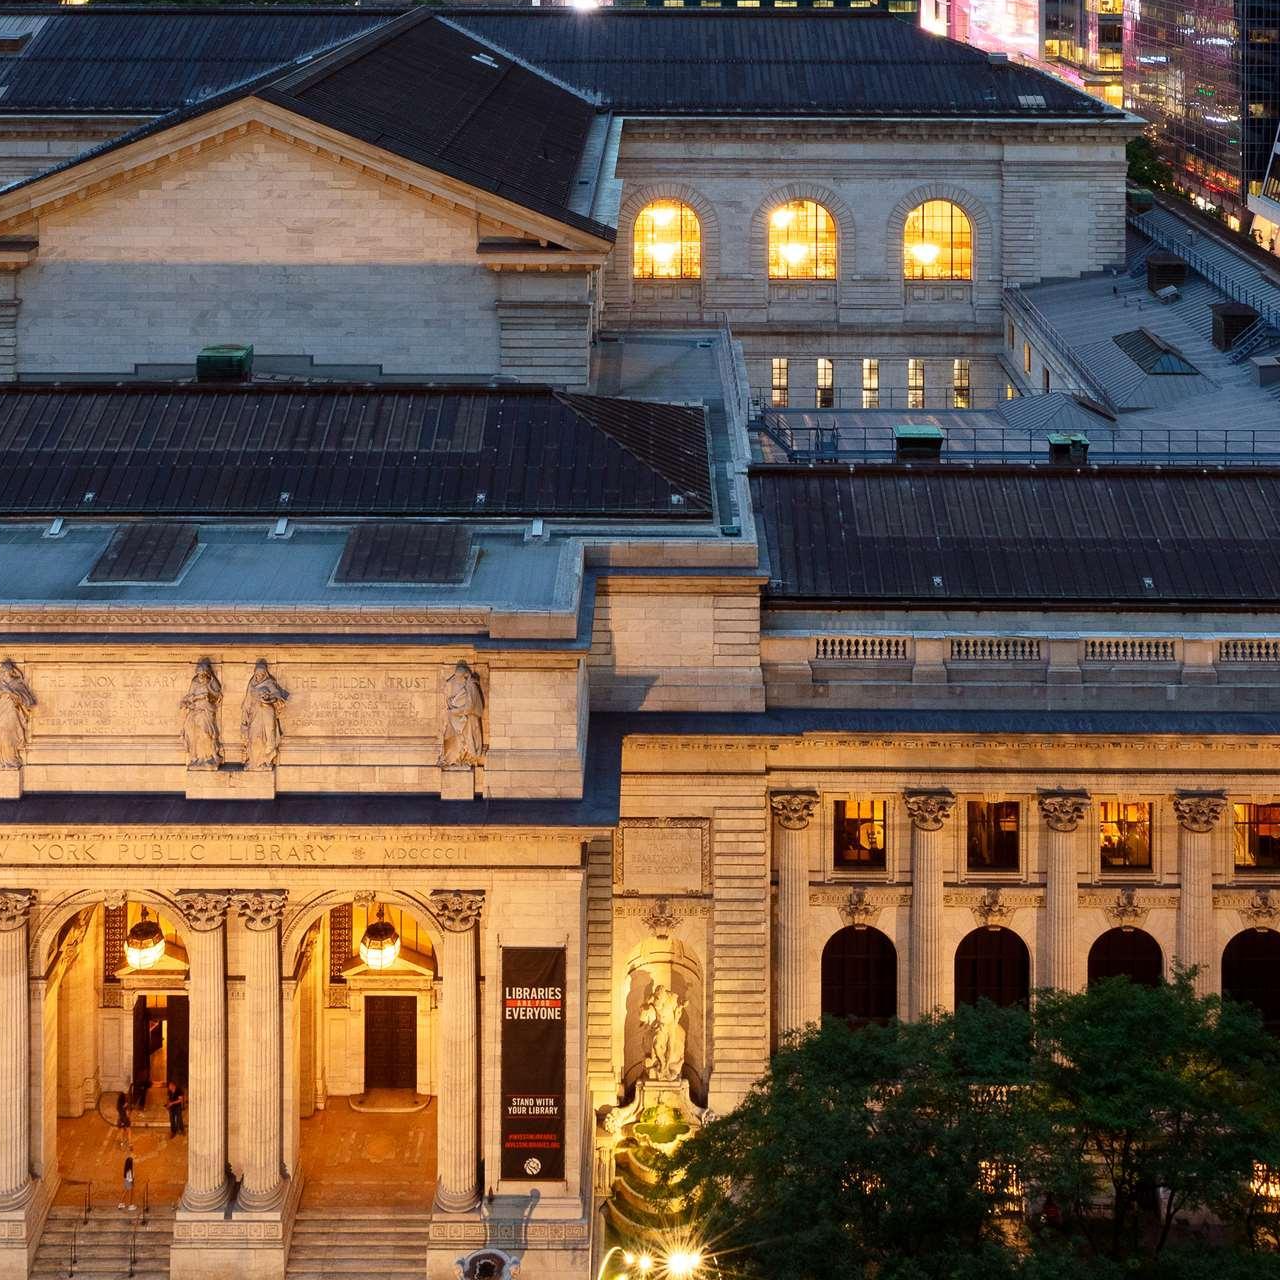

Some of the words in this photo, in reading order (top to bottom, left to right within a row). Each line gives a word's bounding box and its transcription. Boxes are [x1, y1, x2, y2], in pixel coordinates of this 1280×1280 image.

[73, 676, 116, 688] LENOX
[123, 676, 178, 688] LIBRARY
[292, 677, 317, 689] THE
[329, 677, 376, 689] TILDEN
[387, 677, 430, 689] TRUST
[33, 843, 98, 861] YORK
[119, 844, 206, 861] PUBLIC
[229, 844, 334, 862] LIBRARY
[505, 987, 562, 1000] LIBRARIES
[505, 1007, 562, 1020] EVERYONE
[512, 1097, 534, 1106] STAND
[536, 1097, 554, 1106] WITH
[508, 1106, 527, 1115] YOUR
[528, 1106, 559, 1115] LIBRARY
